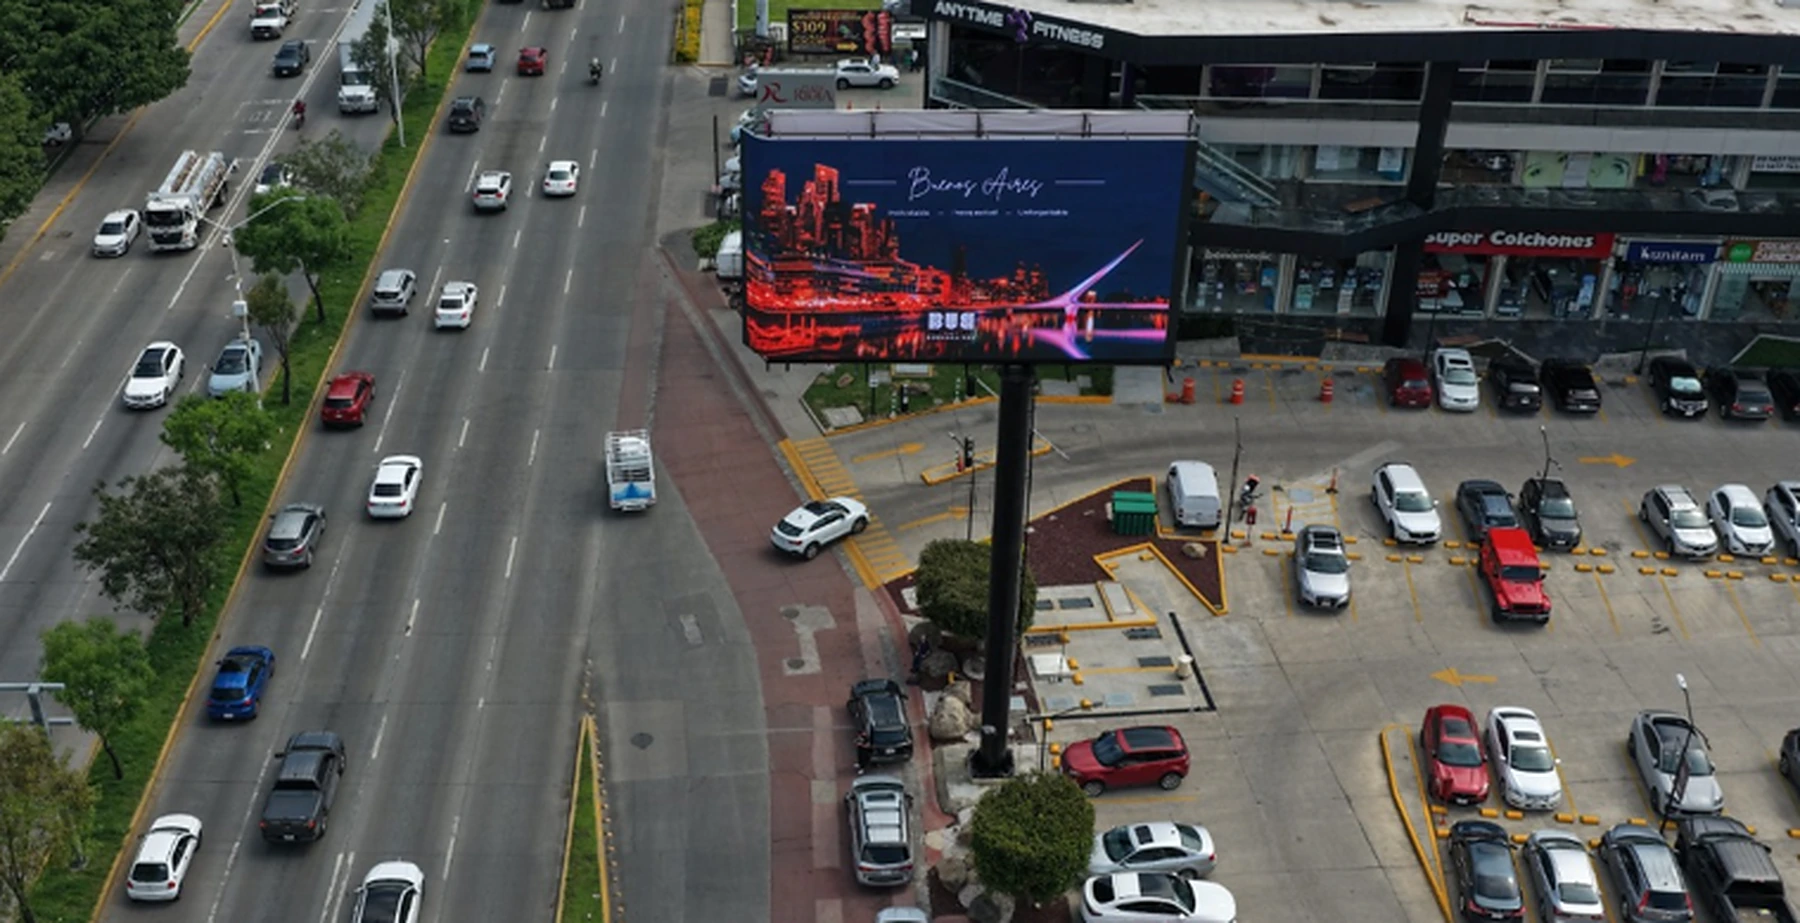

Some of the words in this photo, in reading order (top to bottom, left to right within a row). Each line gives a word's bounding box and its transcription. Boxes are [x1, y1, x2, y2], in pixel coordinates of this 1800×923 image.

[934, 1, 1004, 27] ANYTIME
[1033, 20, 1104, 49] FITNESS
[907, 166, 978, 201] Buenos
[981, 166, 1044, 201] Aires
[1490, 230, 1594, 249] Colchones
